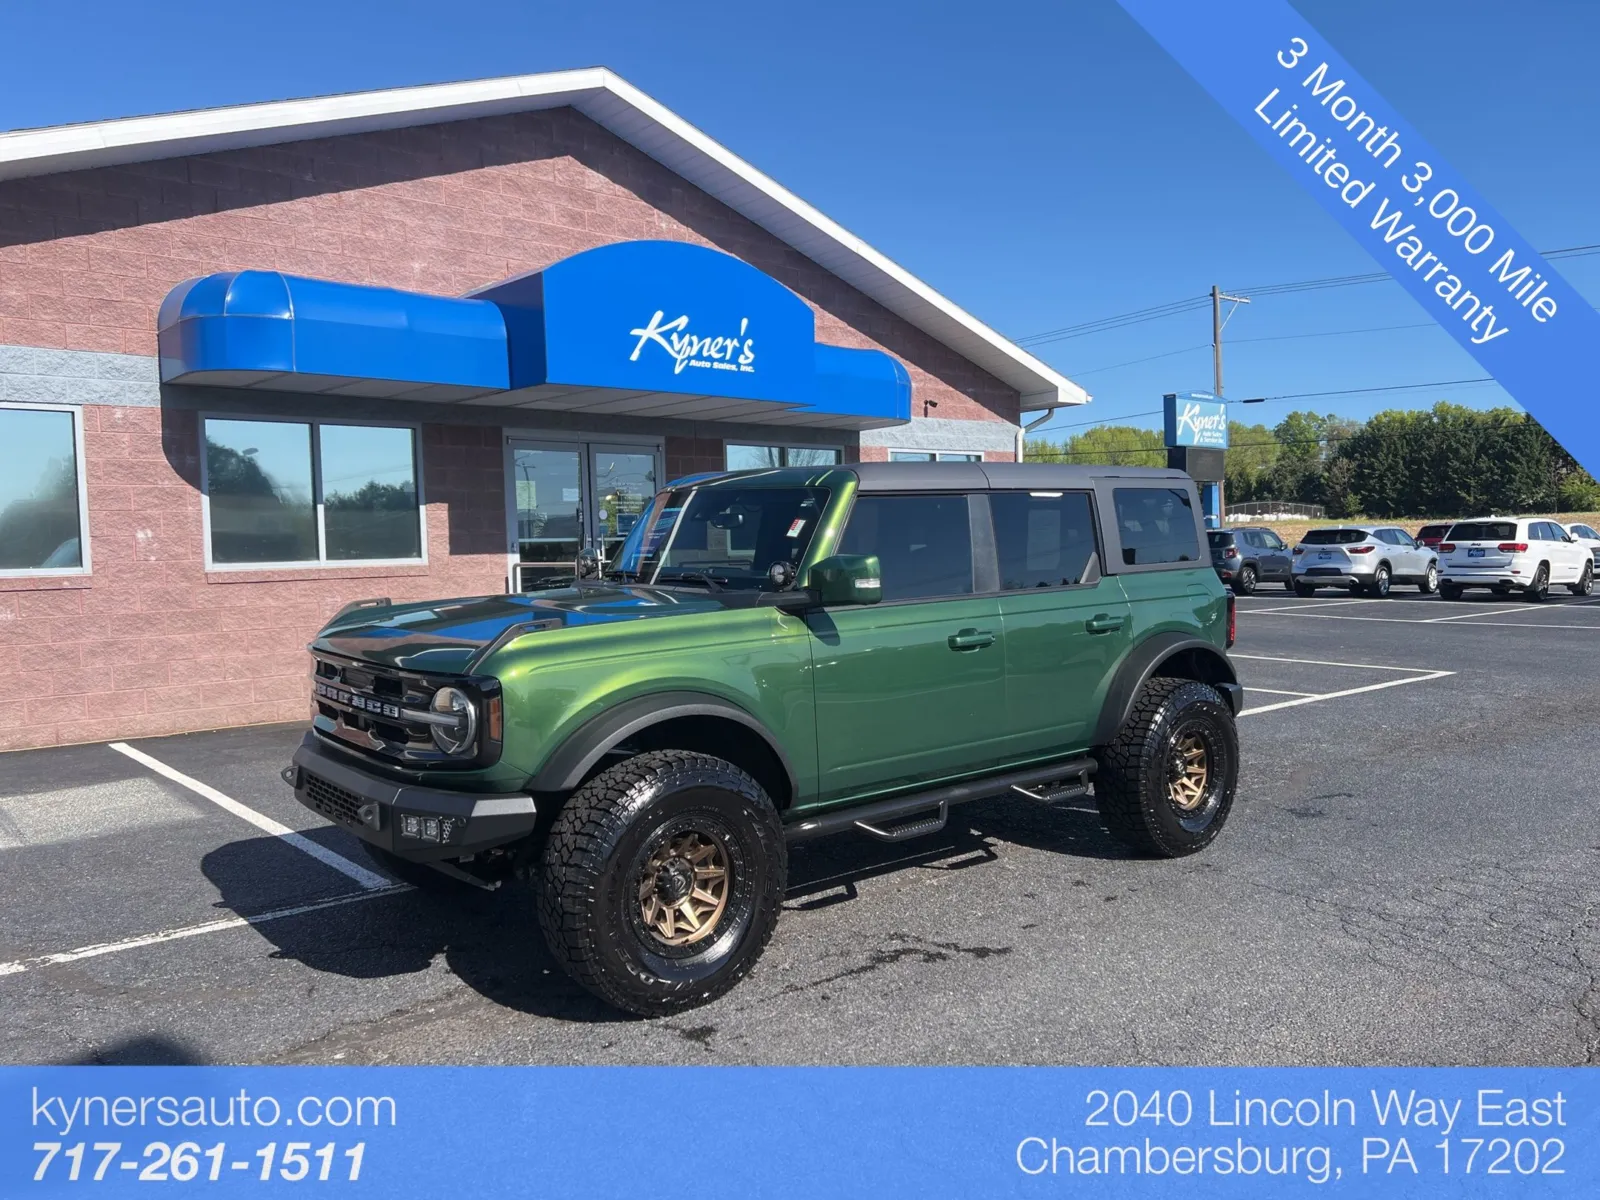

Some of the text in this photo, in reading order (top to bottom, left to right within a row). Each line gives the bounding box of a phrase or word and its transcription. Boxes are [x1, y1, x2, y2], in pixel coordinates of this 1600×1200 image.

[629, 310, 755, 375] Kyner's
[689, 359, 711, 369] Auto
[1178, 403, 1226, 445] Kyner's
[315, 682, 399, 718] BRONCO
